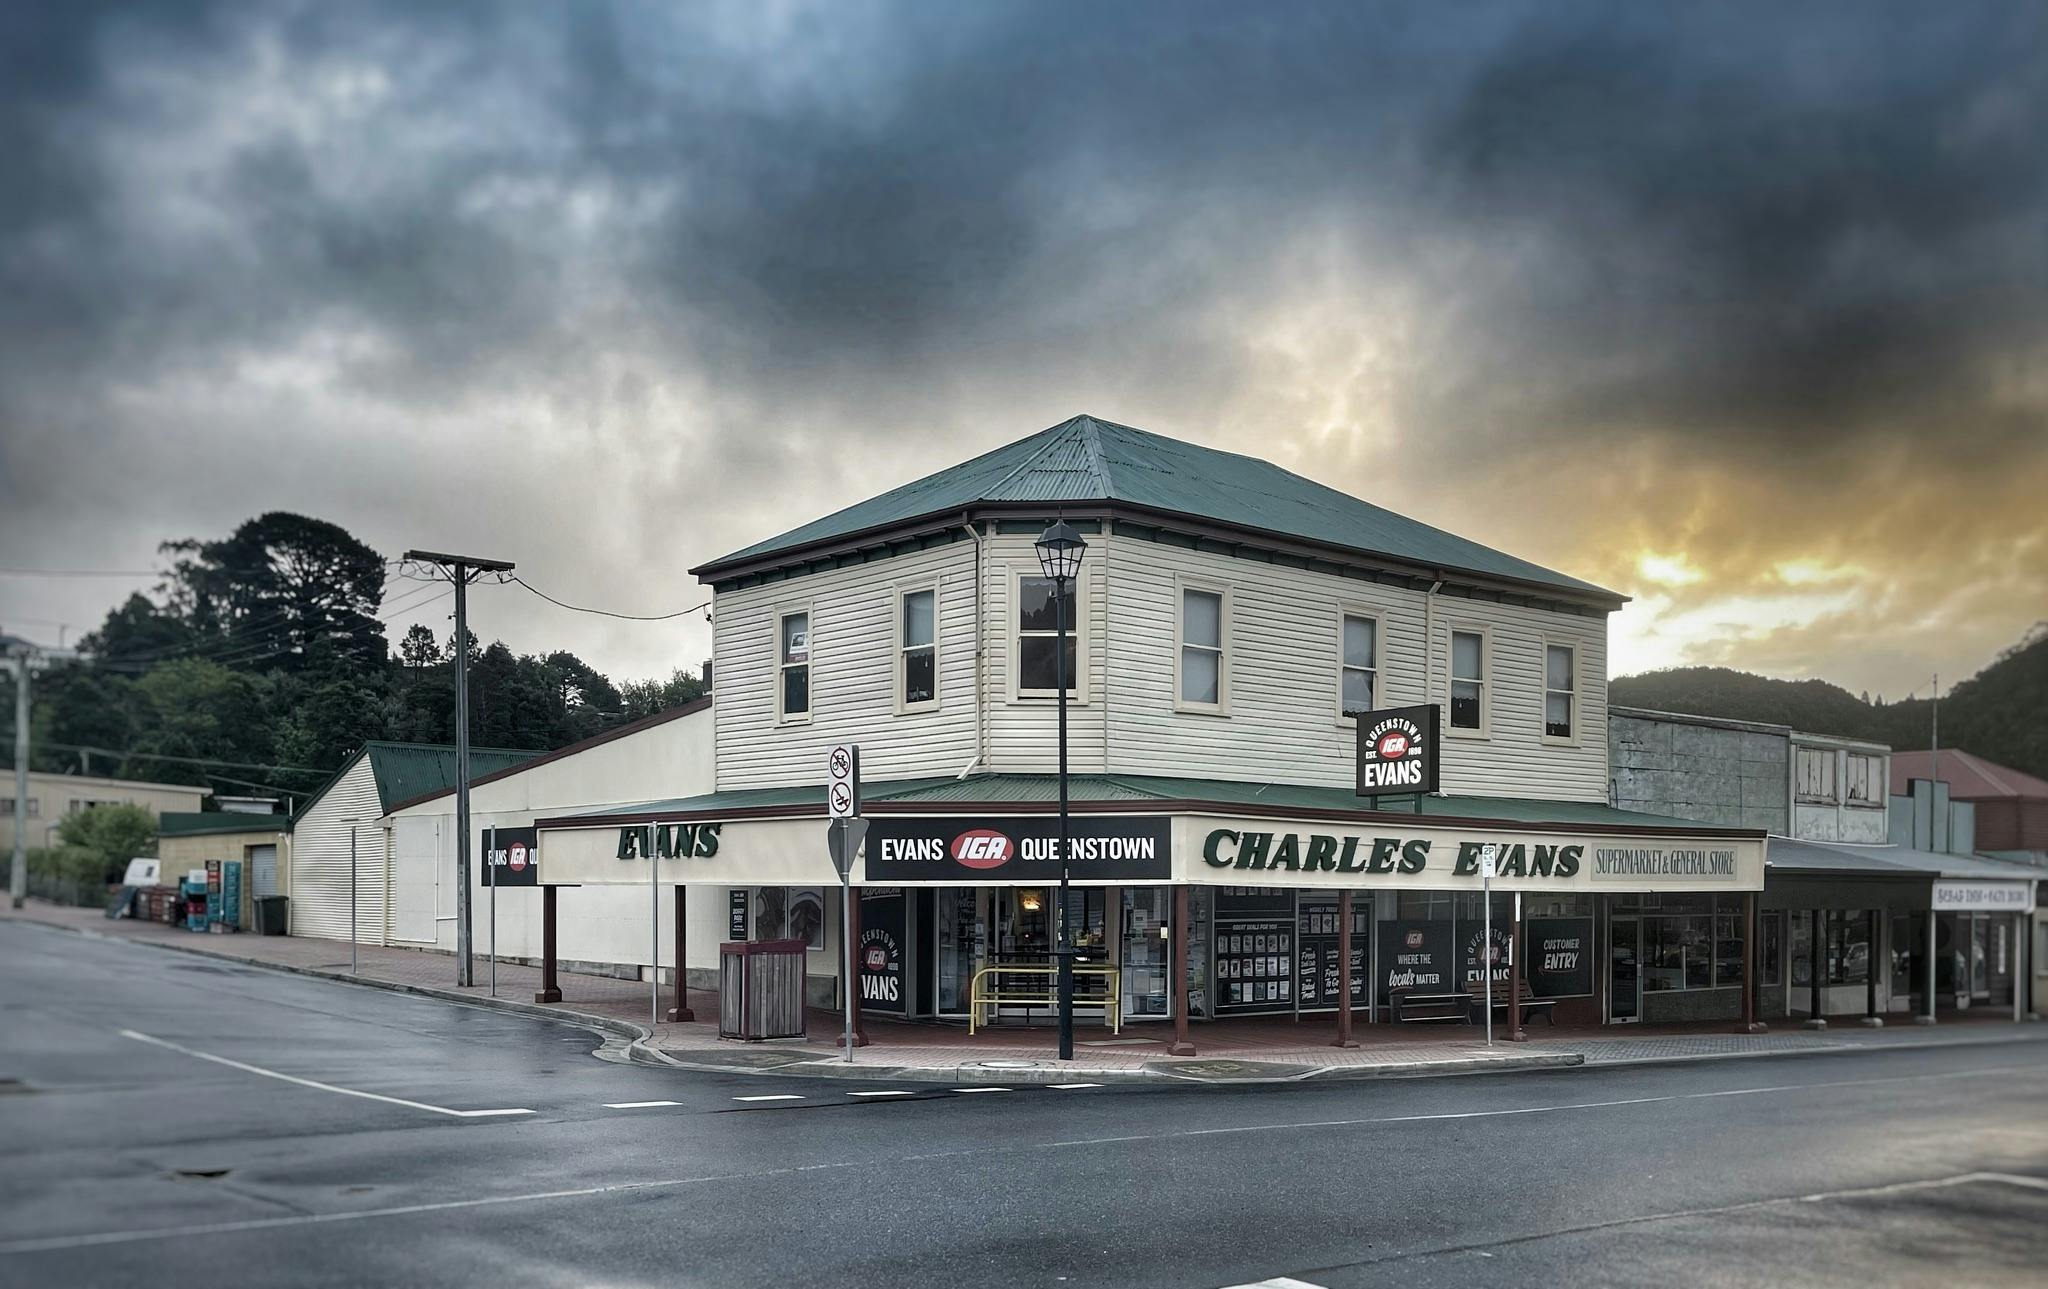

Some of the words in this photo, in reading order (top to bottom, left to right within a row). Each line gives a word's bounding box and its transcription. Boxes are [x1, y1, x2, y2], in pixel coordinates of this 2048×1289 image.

[1365, 717, 1422, 748] QUEENSTOWN
[1381, 737, 1406, 754] IGA
[1364, 759, 1422, 787] EVANS
[487, 849, 507, 866] EANS
[510, 847, 526, 866] IGA
[881, 838, 944, 861] EVANS
[957, 836, 1007, 861] IGA
[1203, 829, 1432, 874] CHARLES
[1596, 848, 1662, 875] SUPERMARKET
[1662, 855, 1669, 873] &
[1670, 850, 1707, 875] GENERAL
[1709, 851, 1734, 875] STORE
[861, 928, 899, 958] EENSTOWN
[1407, 933, 1423, 945] IGA
[1543, 938, 1580, 950] CUSTOMER
[867, 950, 885, 966] IGA
[1397, 953, 1419, 965] WHERE
[1420, 953, 1432, 965] THE
[1544, 952, 1579, 969] ENTRY
[1388, 968, 1415, 987] locals
[1416, 972, 1440, 985] MATTER
[861, 974, 898, 1001] VANS
